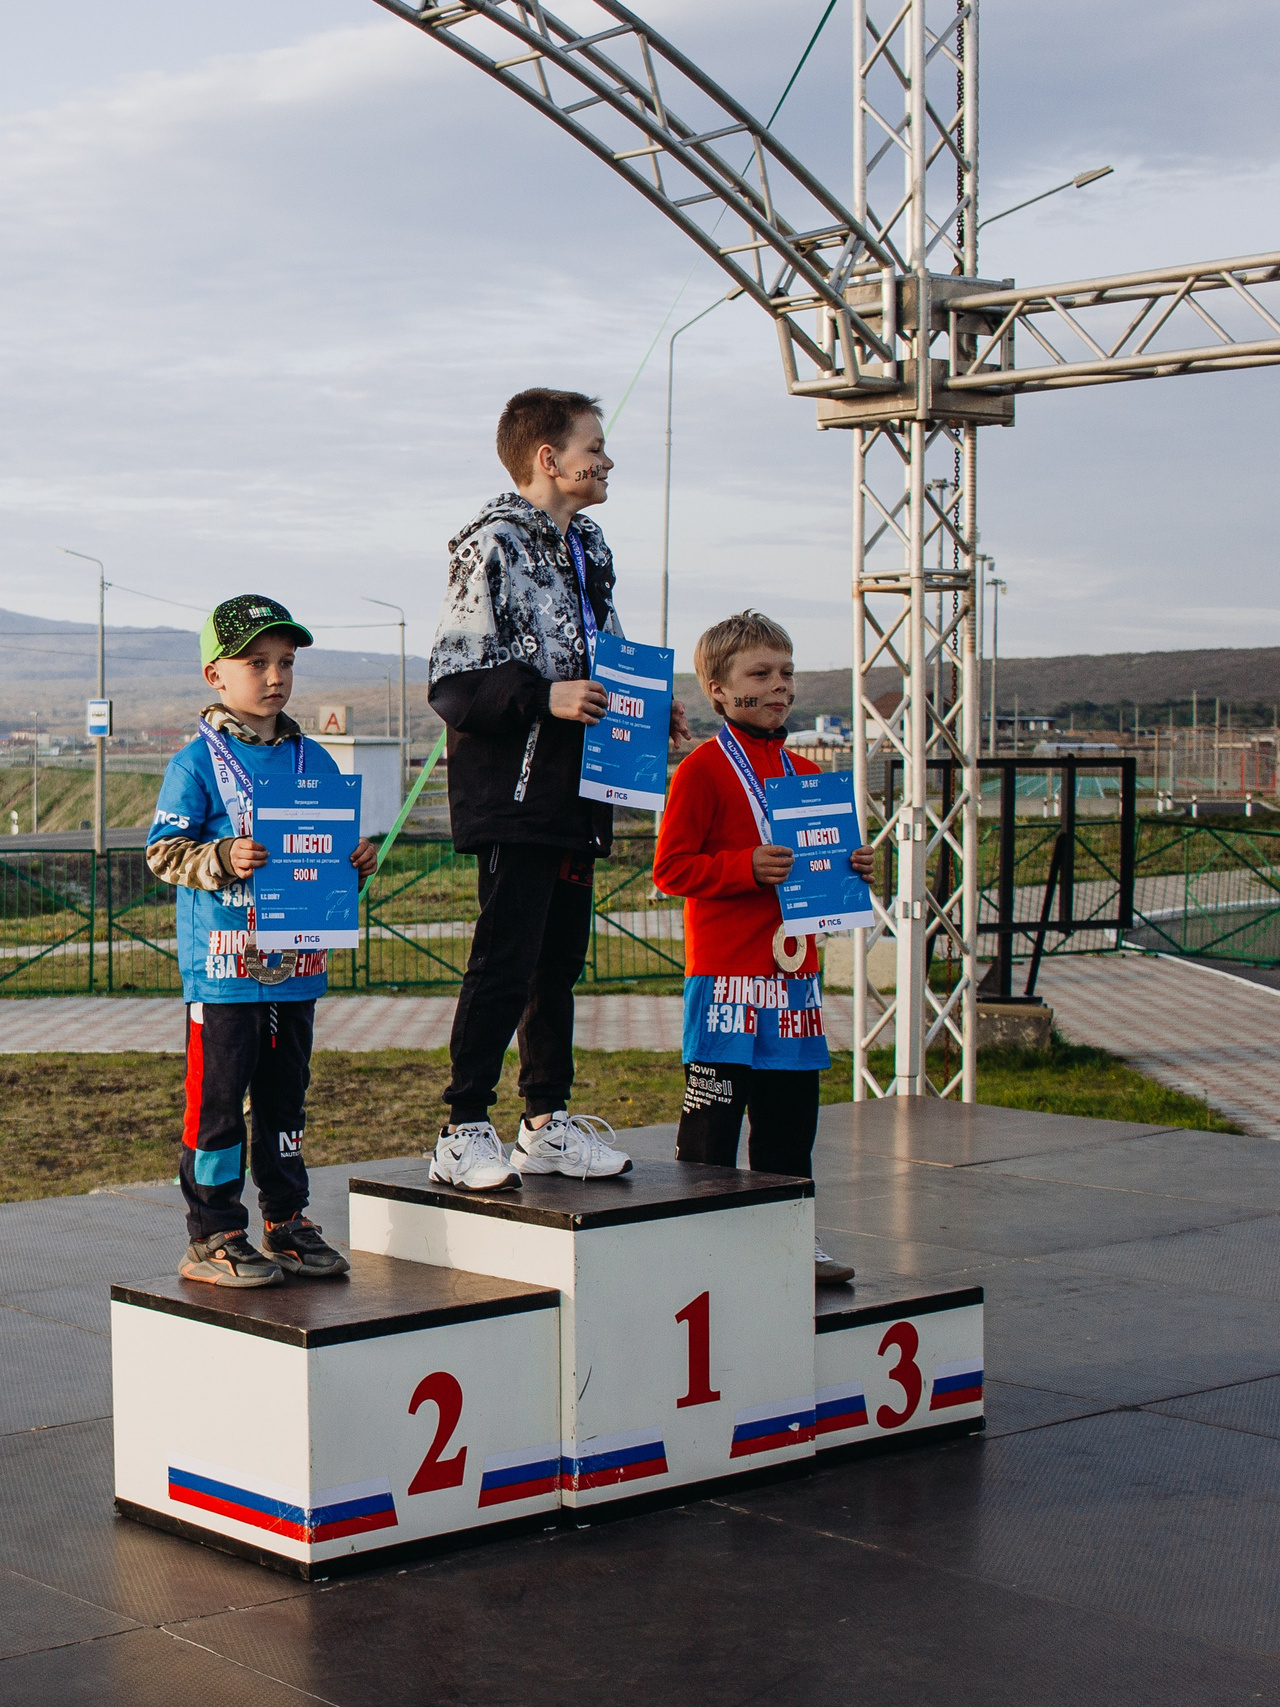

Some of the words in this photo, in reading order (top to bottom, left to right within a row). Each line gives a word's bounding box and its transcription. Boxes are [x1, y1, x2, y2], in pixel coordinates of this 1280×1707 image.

[611, 693, 645, 719] МЕСТО
[611, 727, 624, 741] 500
[218, 763, 230, 784] ПСБ
[229, 759, 254, 794] ОБЛАСТЬ
[614, 792, 628, 800] ПСБ
[154, 810, 191, 830] ПСБ
[293, 834, 333, 854] МЕСТО
[806, 827, 840, 847] МЕСТО
[293, 868, 309, 881] 500
[809, 860, 823, 872] 500
[304, 935, 321, 943] ПСБ
[674, 1291, 721, 1409] 1
[876, 1321, 921, 1430] 3
[407, 1371, 469, 1497] 2
